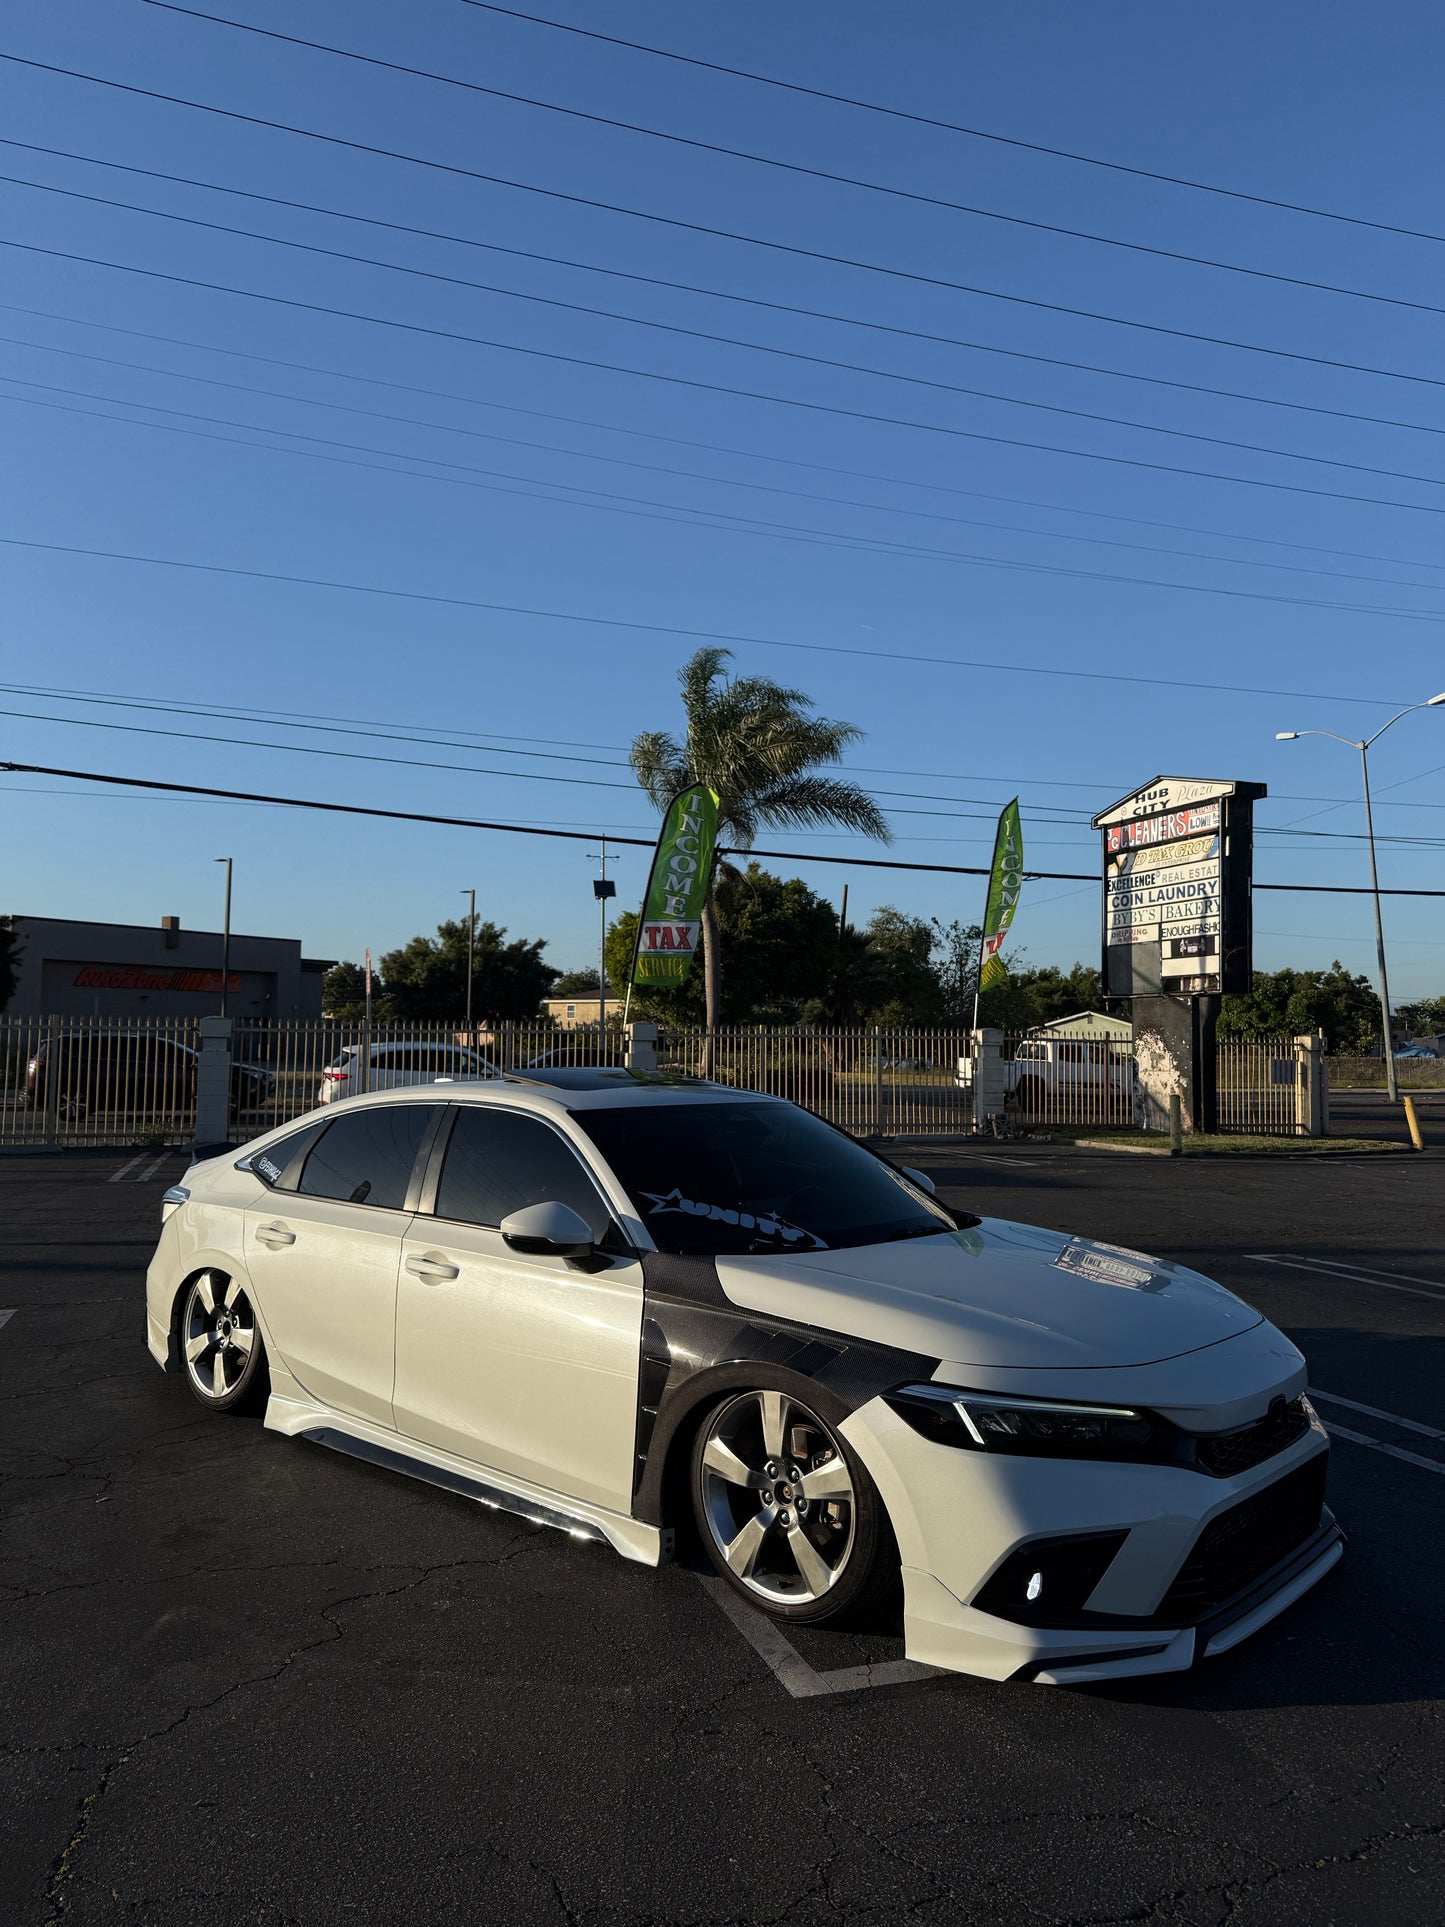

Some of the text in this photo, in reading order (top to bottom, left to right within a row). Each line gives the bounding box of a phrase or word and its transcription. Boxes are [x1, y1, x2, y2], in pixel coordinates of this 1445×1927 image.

[1132, 799, 1171, 816] CITY
[1134, 788, 1169, 804] HUB
[1120, 811, 1188, 849] CLEANERS
[661, 793, 705, 918] INCOME
[1148, 846, 1174, 864] TAX
[1107, 872, 1156, 892] EXCELLENCE
[1162, 867, 1185, 883] REAL
[1111, 880, 1218, 909] COIN LAUNDRY
[1113, 908, 1156, 926] BYBY'S
[1166, 898, 1220, 919] BAKERY
[644, 926, 692, 950] TAX
[75, 966, 170, 989] AutoZone
